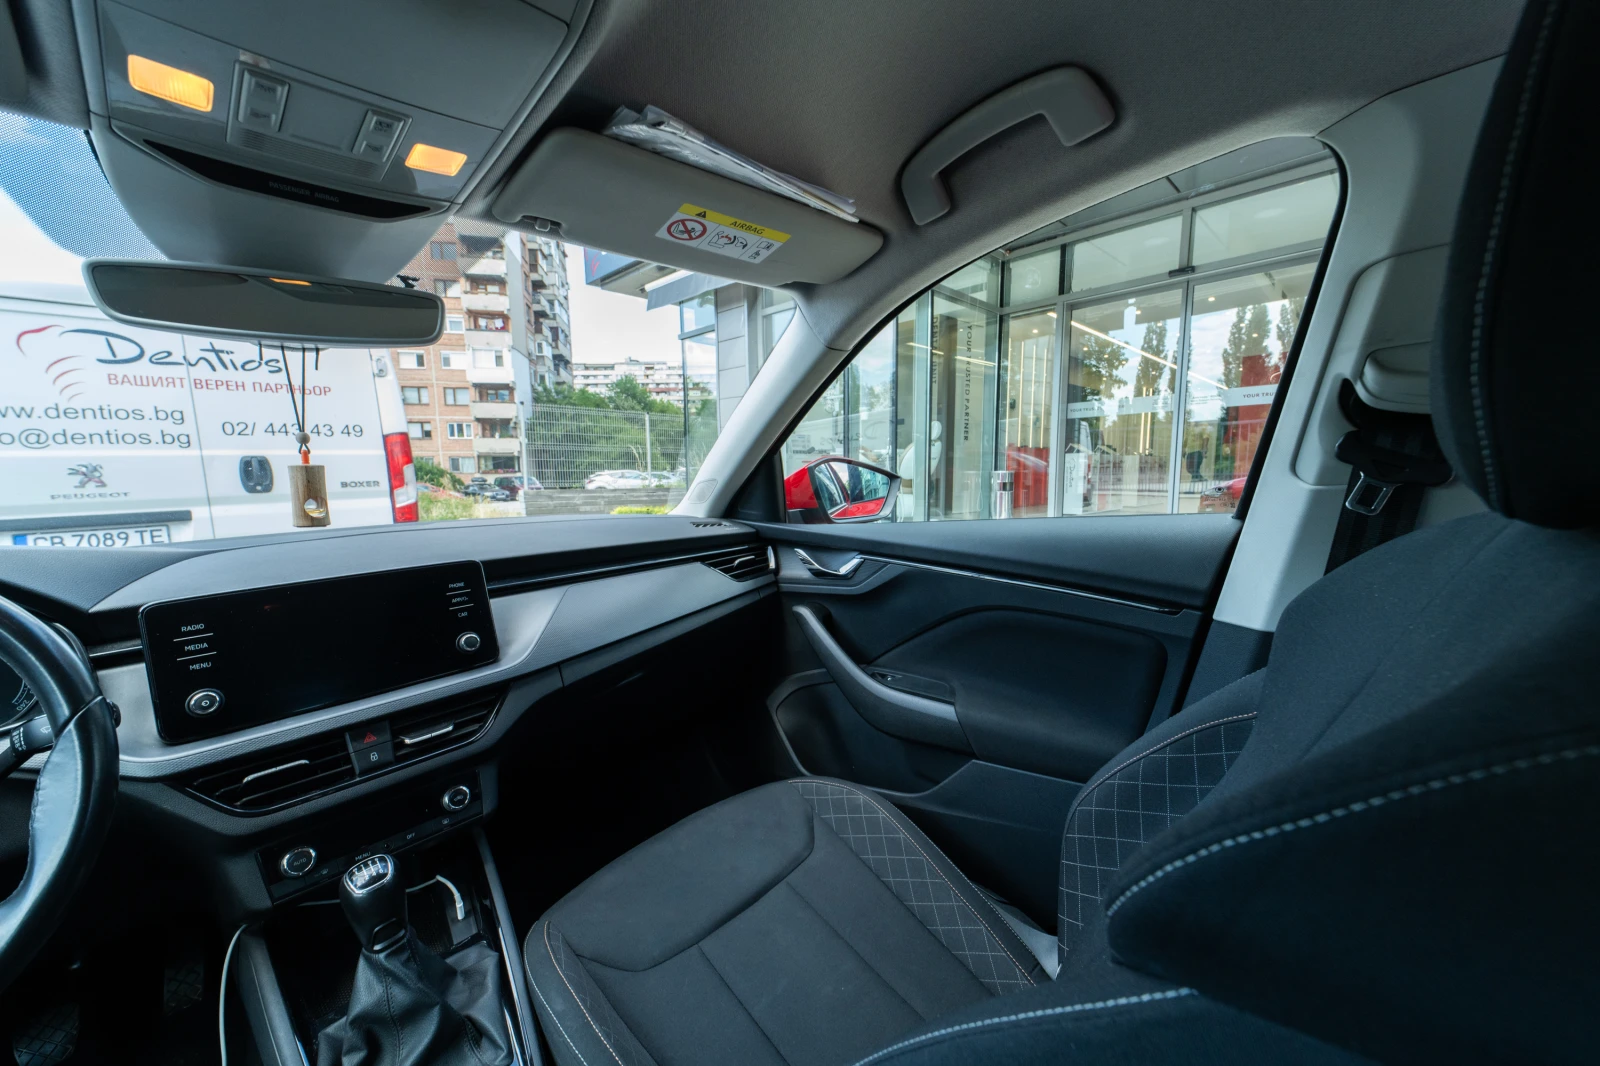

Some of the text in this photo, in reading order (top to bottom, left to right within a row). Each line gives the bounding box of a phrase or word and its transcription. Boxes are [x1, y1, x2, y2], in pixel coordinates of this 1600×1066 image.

[268, 180, 340, 203] PASSENGER AIRBAG
[729, 220, 766, 235] AIRBAG
[59, 328, 284, 374] Dentios
[964, 355, 972, 396] TRUSTED
[107, 373, 187, 389] ВАШИЯТ
[193, 378, 246, 391] ВЕРЕН
[222, 421, 256, 436] 02/
[310, 424, 334, 438] 43
[341, 424, 364, 438] 49
[340, 480, 380, 488] BOXER
[51, 491, 131, 500] PEUGEOT
[71, 531, 130, 547] 7089
[135, 528, 163, 545] TE
[181, 623, 205, 632] RADIO
[184, 642, 209, 652] MEDIA
[189, 661, 212, 671] MENU
[406, 832, 416, 840] OFF
[355, 851, 371, 861] MENU
[293, 857, 307, 867] AUTO
